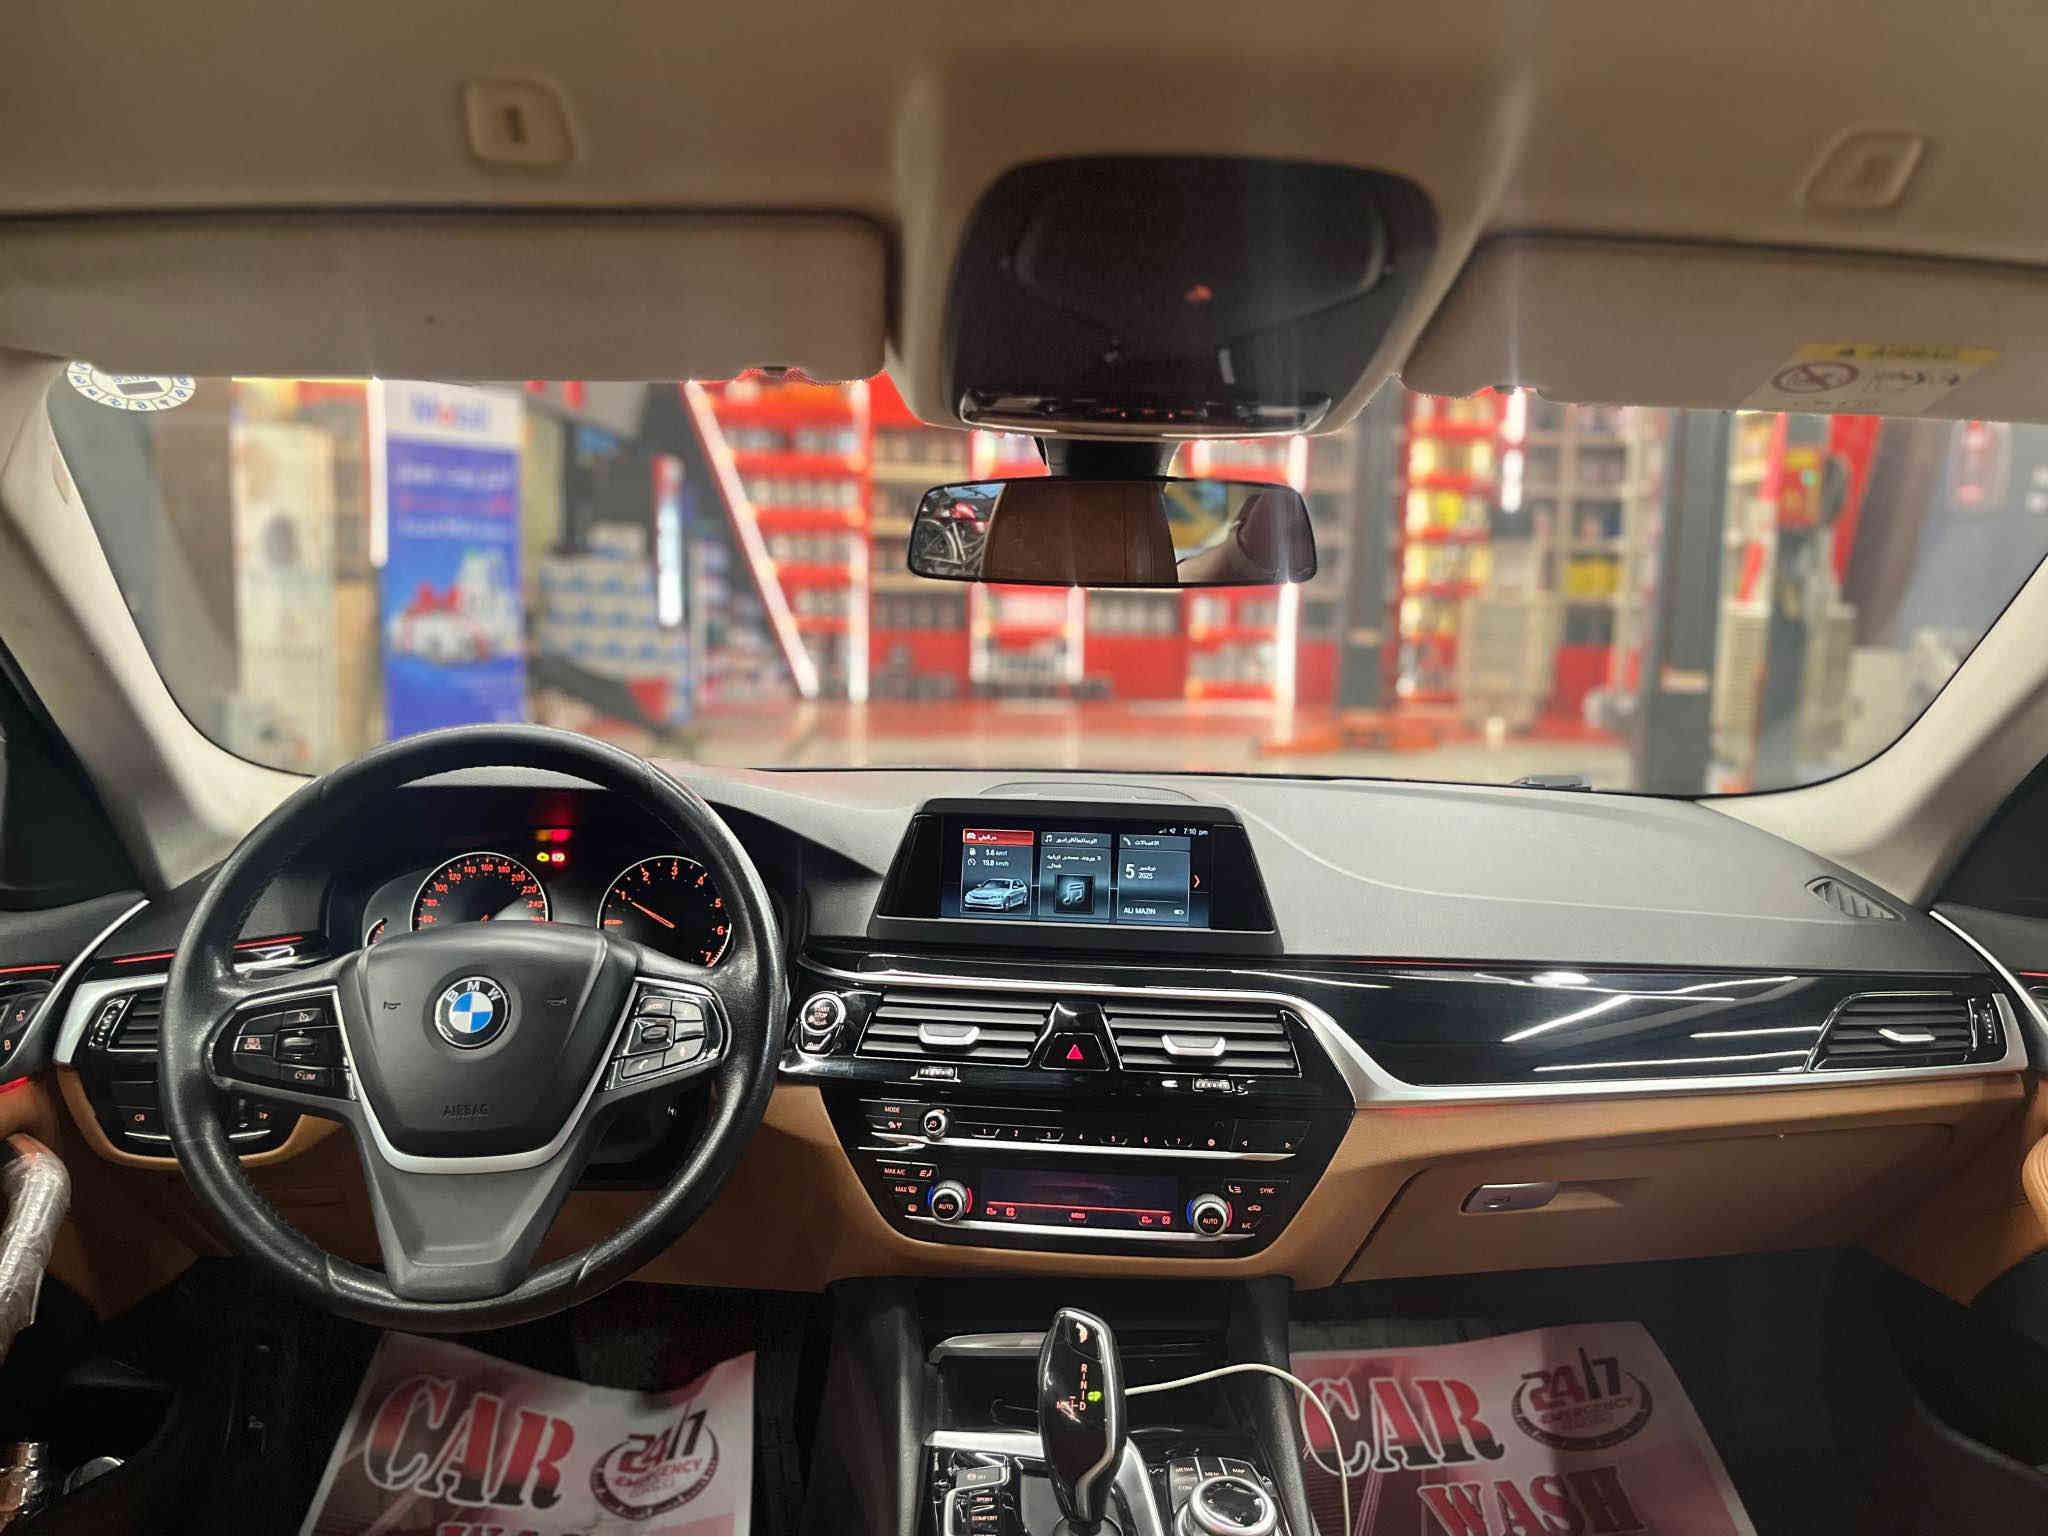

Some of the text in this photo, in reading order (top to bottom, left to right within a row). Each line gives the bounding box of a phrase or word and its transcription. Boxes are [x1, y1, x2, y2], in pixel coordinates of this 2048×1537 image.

[642, 871, 650, 881] 2
[671, 866, 679, 877] 3
[1125, 863, 1136, 880] 5
[697, 876, 705, 885] 4
[714, 897, 723, 908] 5
[716, 925, 725, 936] 6
[445, 980, 503, 1003] BMW
[938, 1203, 955, 1211] AUTO
[1202, 1217, 1219, 1225] AUTO
[1079, 1363, 1088, 1410] R N D
[1299, 1375, 1506, 1477] CAR
[366, 1377, 575, 1510] CAR
